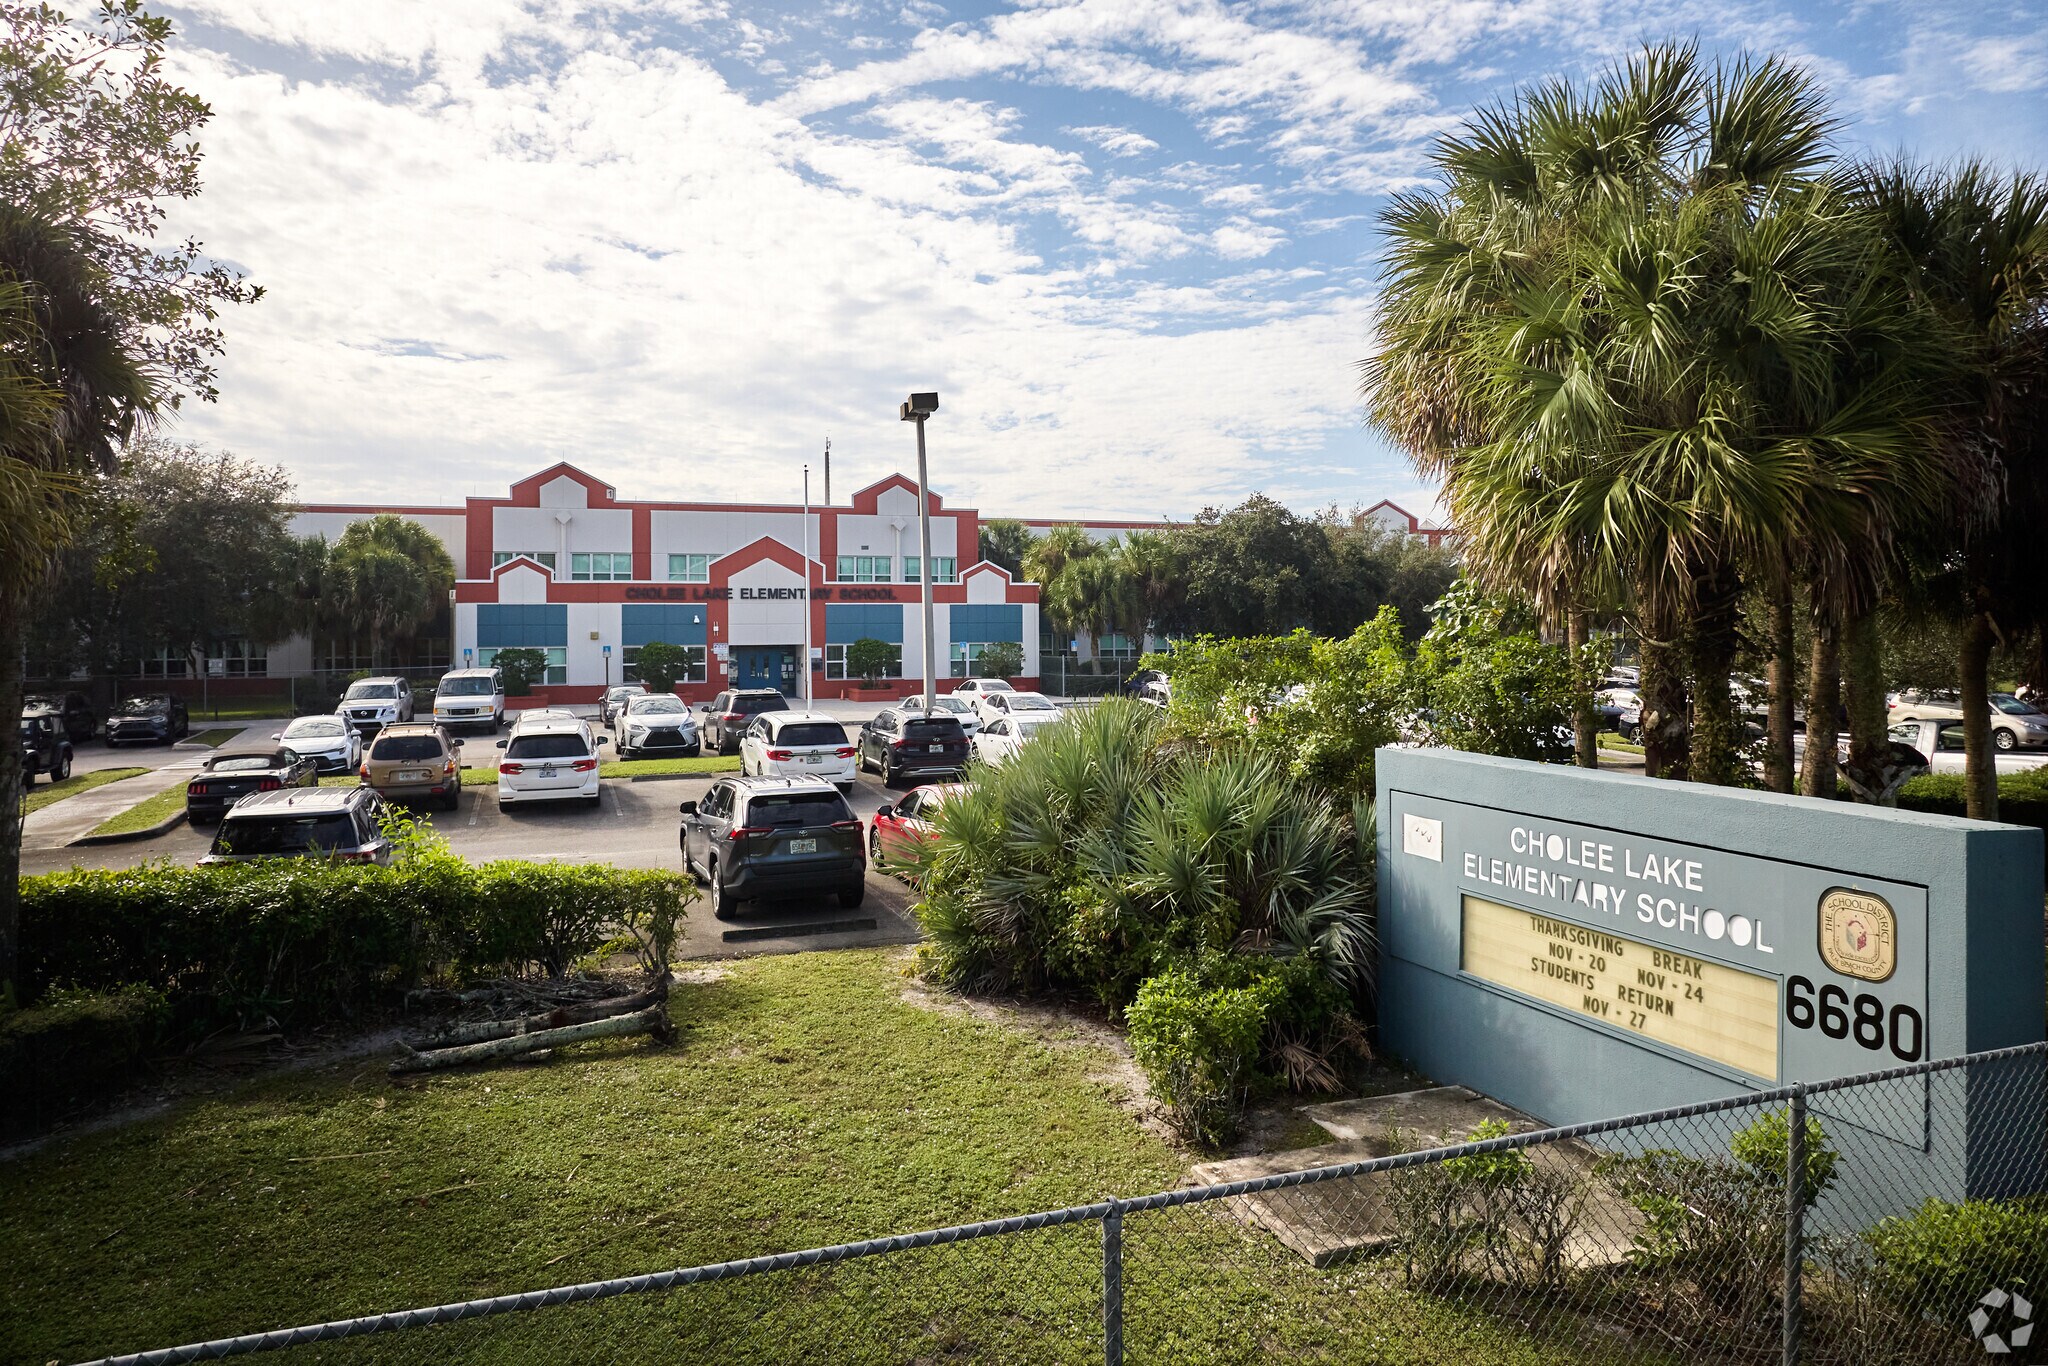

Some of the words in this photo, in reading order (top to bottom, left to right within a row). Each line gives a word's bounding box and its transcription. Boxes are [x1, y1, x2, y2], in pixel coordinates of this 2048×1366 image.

[625, 587, 686, 601] CHOLEE
[693, 587, 733, 601] LAKE
[838, 587, 897, 601] SCHOOL
[1510, 827, 1614, 873] CHOLEE
[1625, 848, 1703, 893] LAKE
[1463, 852, 1626, 915] ELEMENTARY
[1636, 893, 1774, 954] SCHOOL
[1825, 912, 1833, 932] THE
[1828, 897, 1865, 912] SCHOOL
[1866, 902, 1890, 947] DISTRICT
[1530, 916, 1624, 957] THANKSGIVING
[1652, 951, 1703, 980] BREAK
[1549, 942, 1573, 962] NOV
[1589, 954, 1606, 973] 20
[1637, 968, 1665, 991] NOV
[1684, 983, 1704, 1003] 24
[1531, 957, 1594, 990] STUDENTS
[1618, 984, 1674, 1017] RETURN
[1583, 995, 1609, 1016] NOV
[1630, 1010, 1647, 1029] 27
[1786, 974, 1923, 1063] 6680
